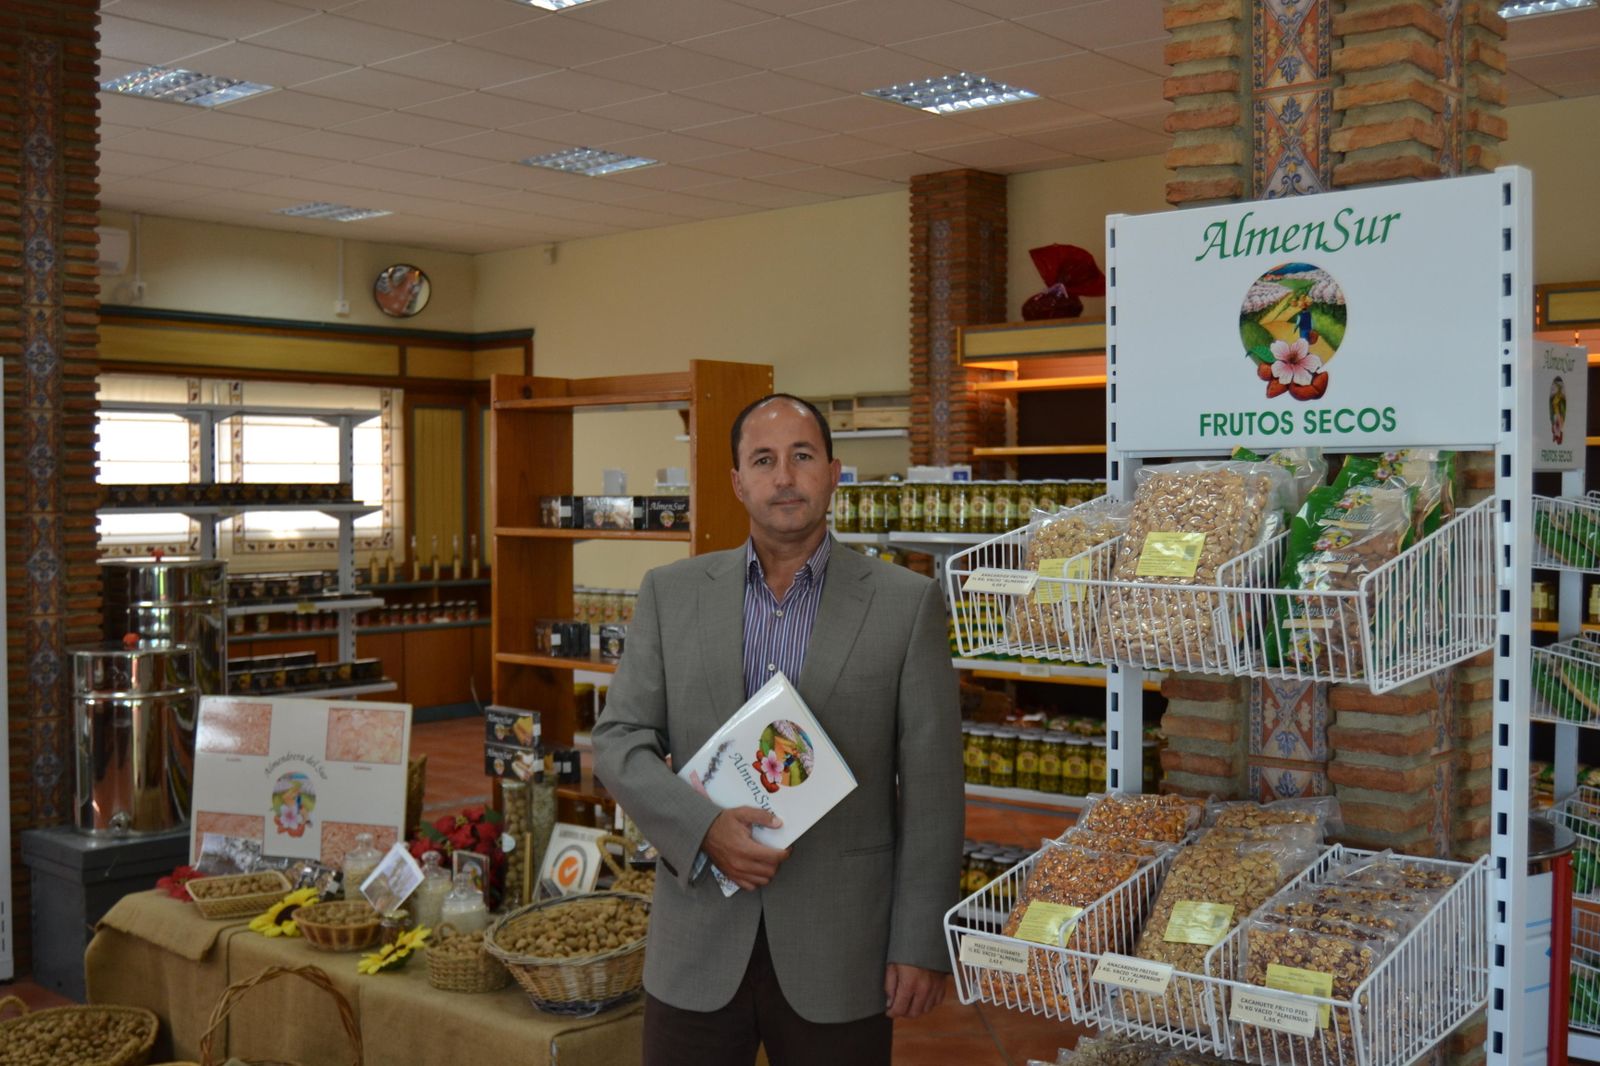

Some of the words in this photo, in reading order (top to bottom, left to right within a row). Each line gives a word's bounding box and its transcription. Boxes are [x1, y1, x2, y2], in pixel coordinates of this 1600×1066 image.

[1194, 206, 1402, 262] AlmenSur
[1199, 409, 1294, 437] FRUTOS
[1303, 406, 1397, 434] SECOS
[1240, 997, 1274, 1009] CACAHUETE
[1274, 1004, 1294, 1013] FRITO
[1294, 1008, 1308, 1017] PIEL
